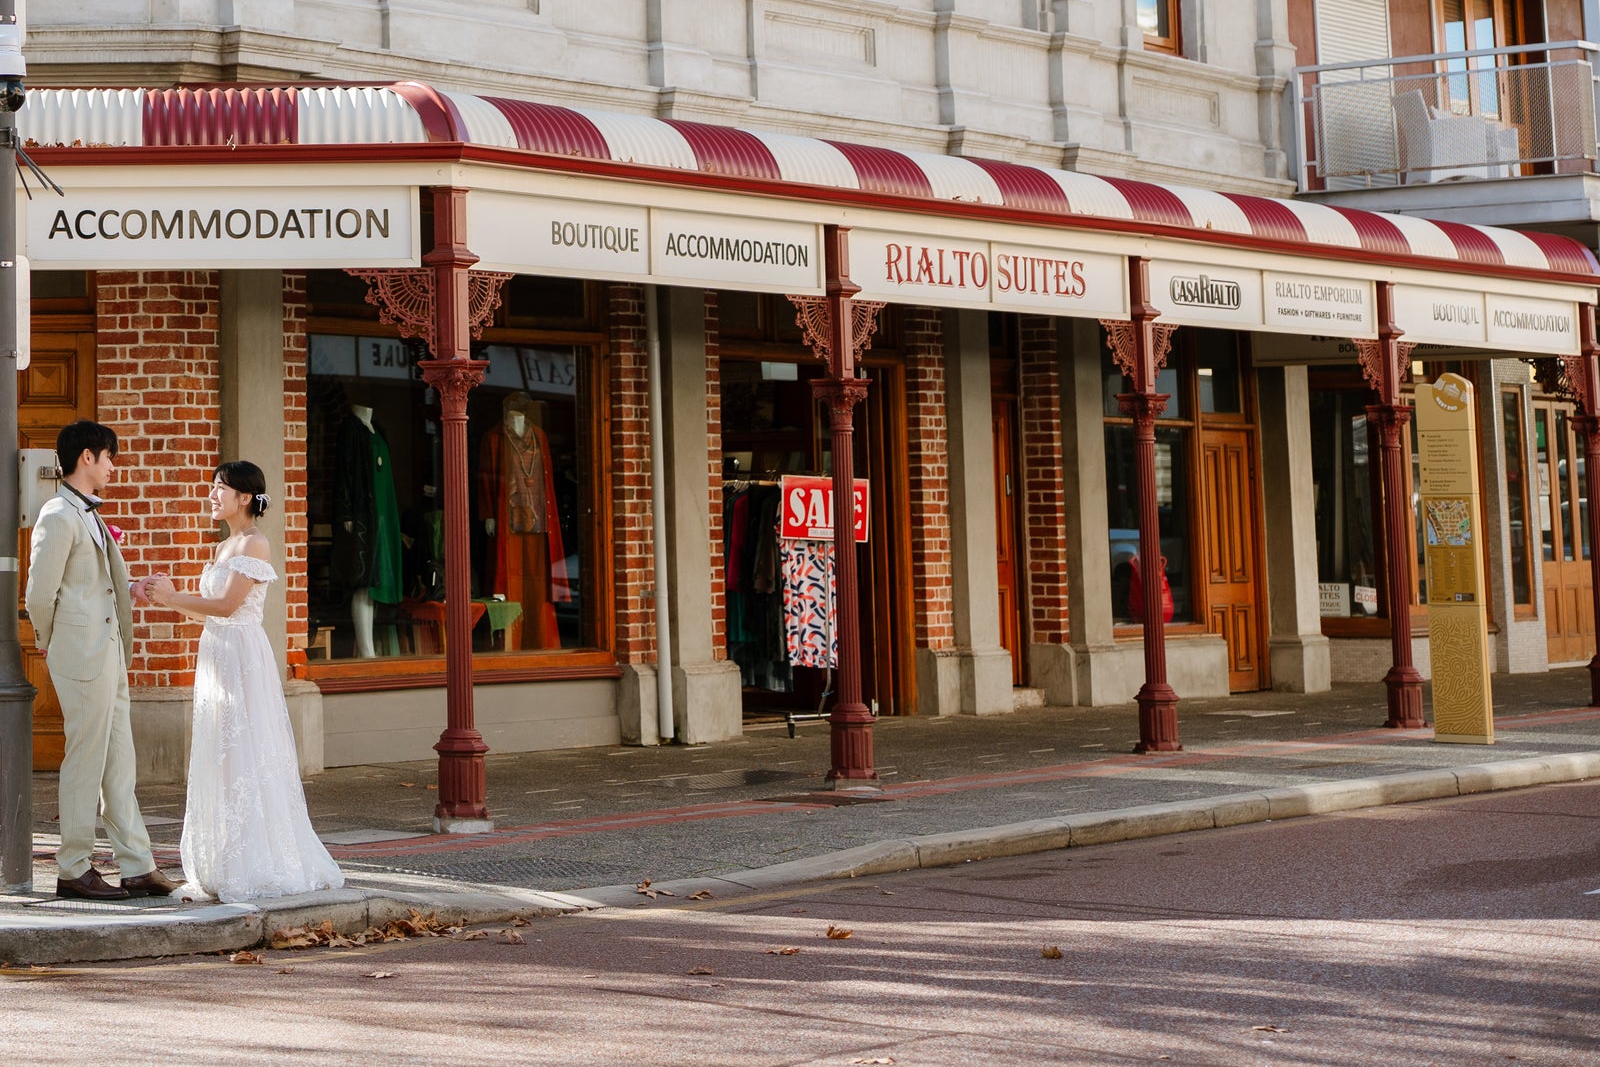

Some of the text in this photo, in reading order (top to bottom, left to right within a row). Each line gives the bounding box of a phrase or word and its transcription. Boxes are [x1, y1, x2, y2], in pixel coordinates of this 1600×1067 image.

[48, 209, 390, 240] ACCOMMODATION
[551, 220, 809, 268] BOUTIQUE ACCOMMODATION
[885, 243, 1087, 299] RIALTO SUITES
[1275, 281, 1363, 304] RIALTO EMPORIUM
[1277, 307, 1363, 323] FASHION GIFTWARES FURNITURE
[1432, 303, 1571, 334] BOUTIQUE ACCOMMODATION
